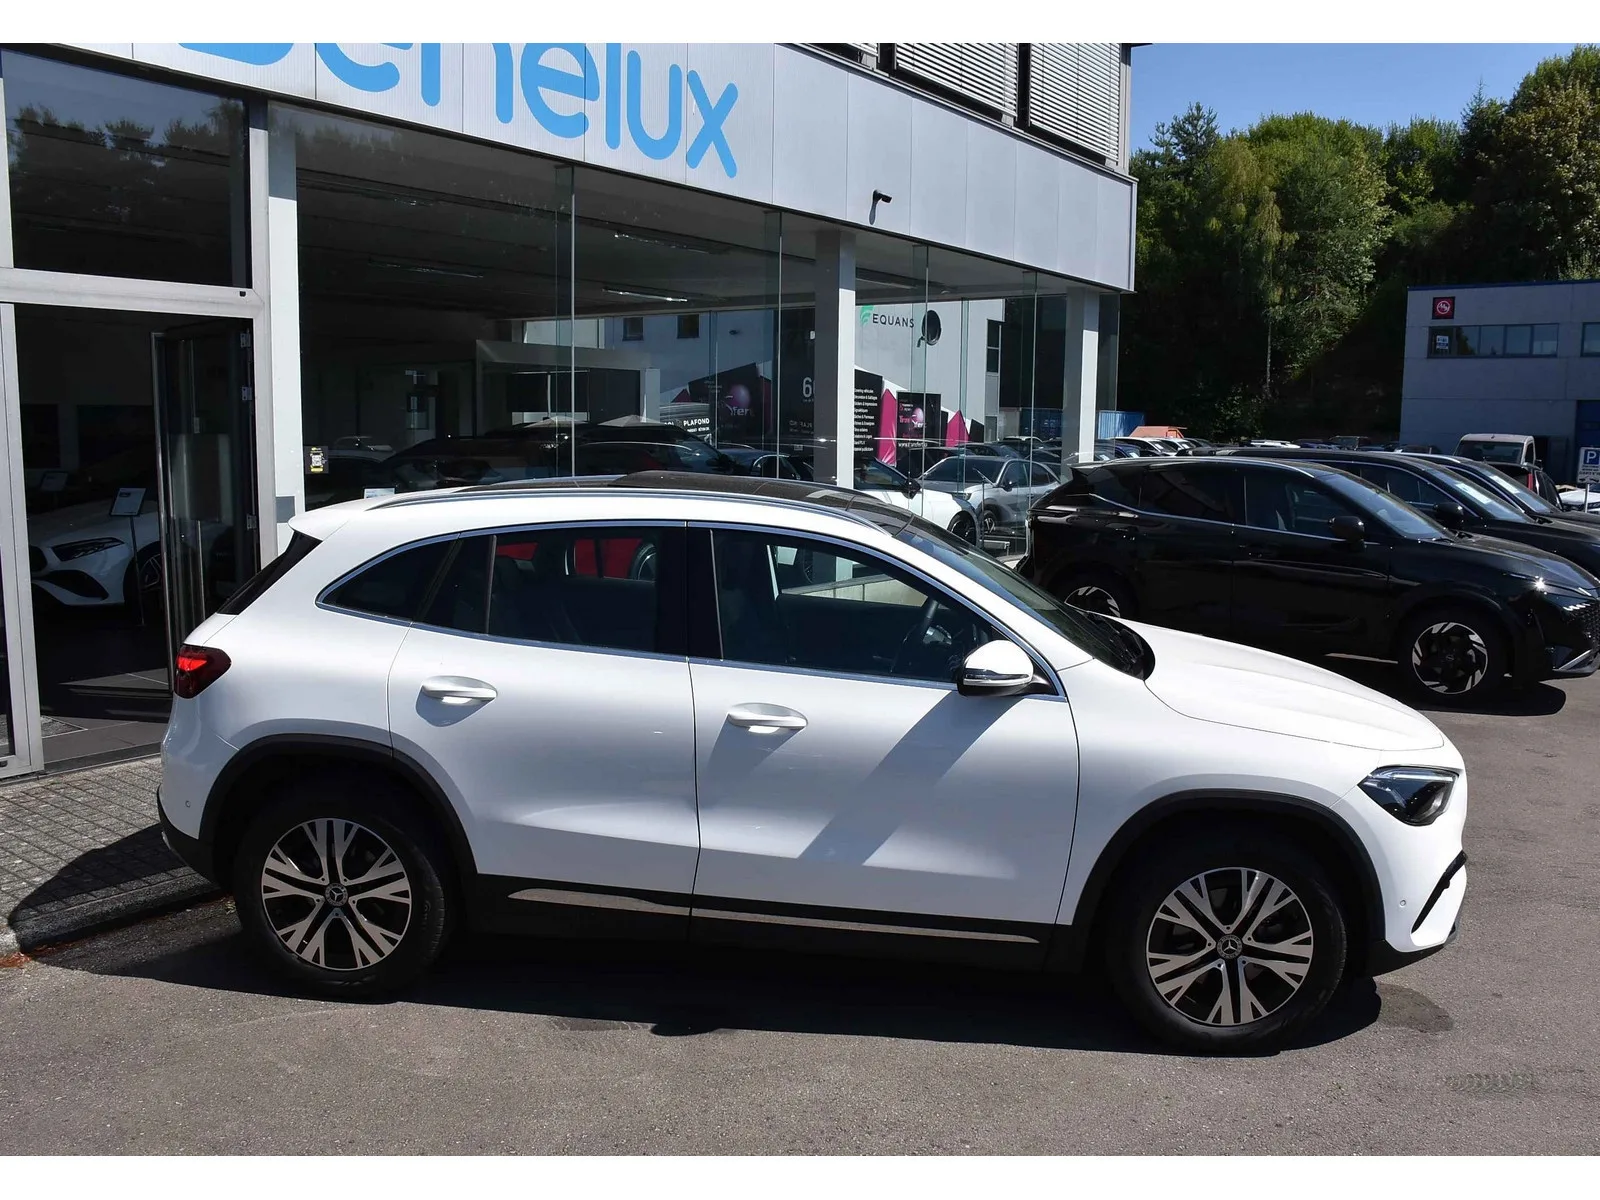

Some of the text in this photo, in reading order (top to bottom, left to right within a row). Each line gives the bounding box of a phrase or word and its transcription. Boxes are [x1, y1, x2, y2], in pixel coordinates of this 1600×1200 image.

[872, 314, 915, 328] EQUANS
[803, 376, 816, 398] 6
[683, 417, 710, 427] PLAFOND
[1586, 450, 1597, 463] P
